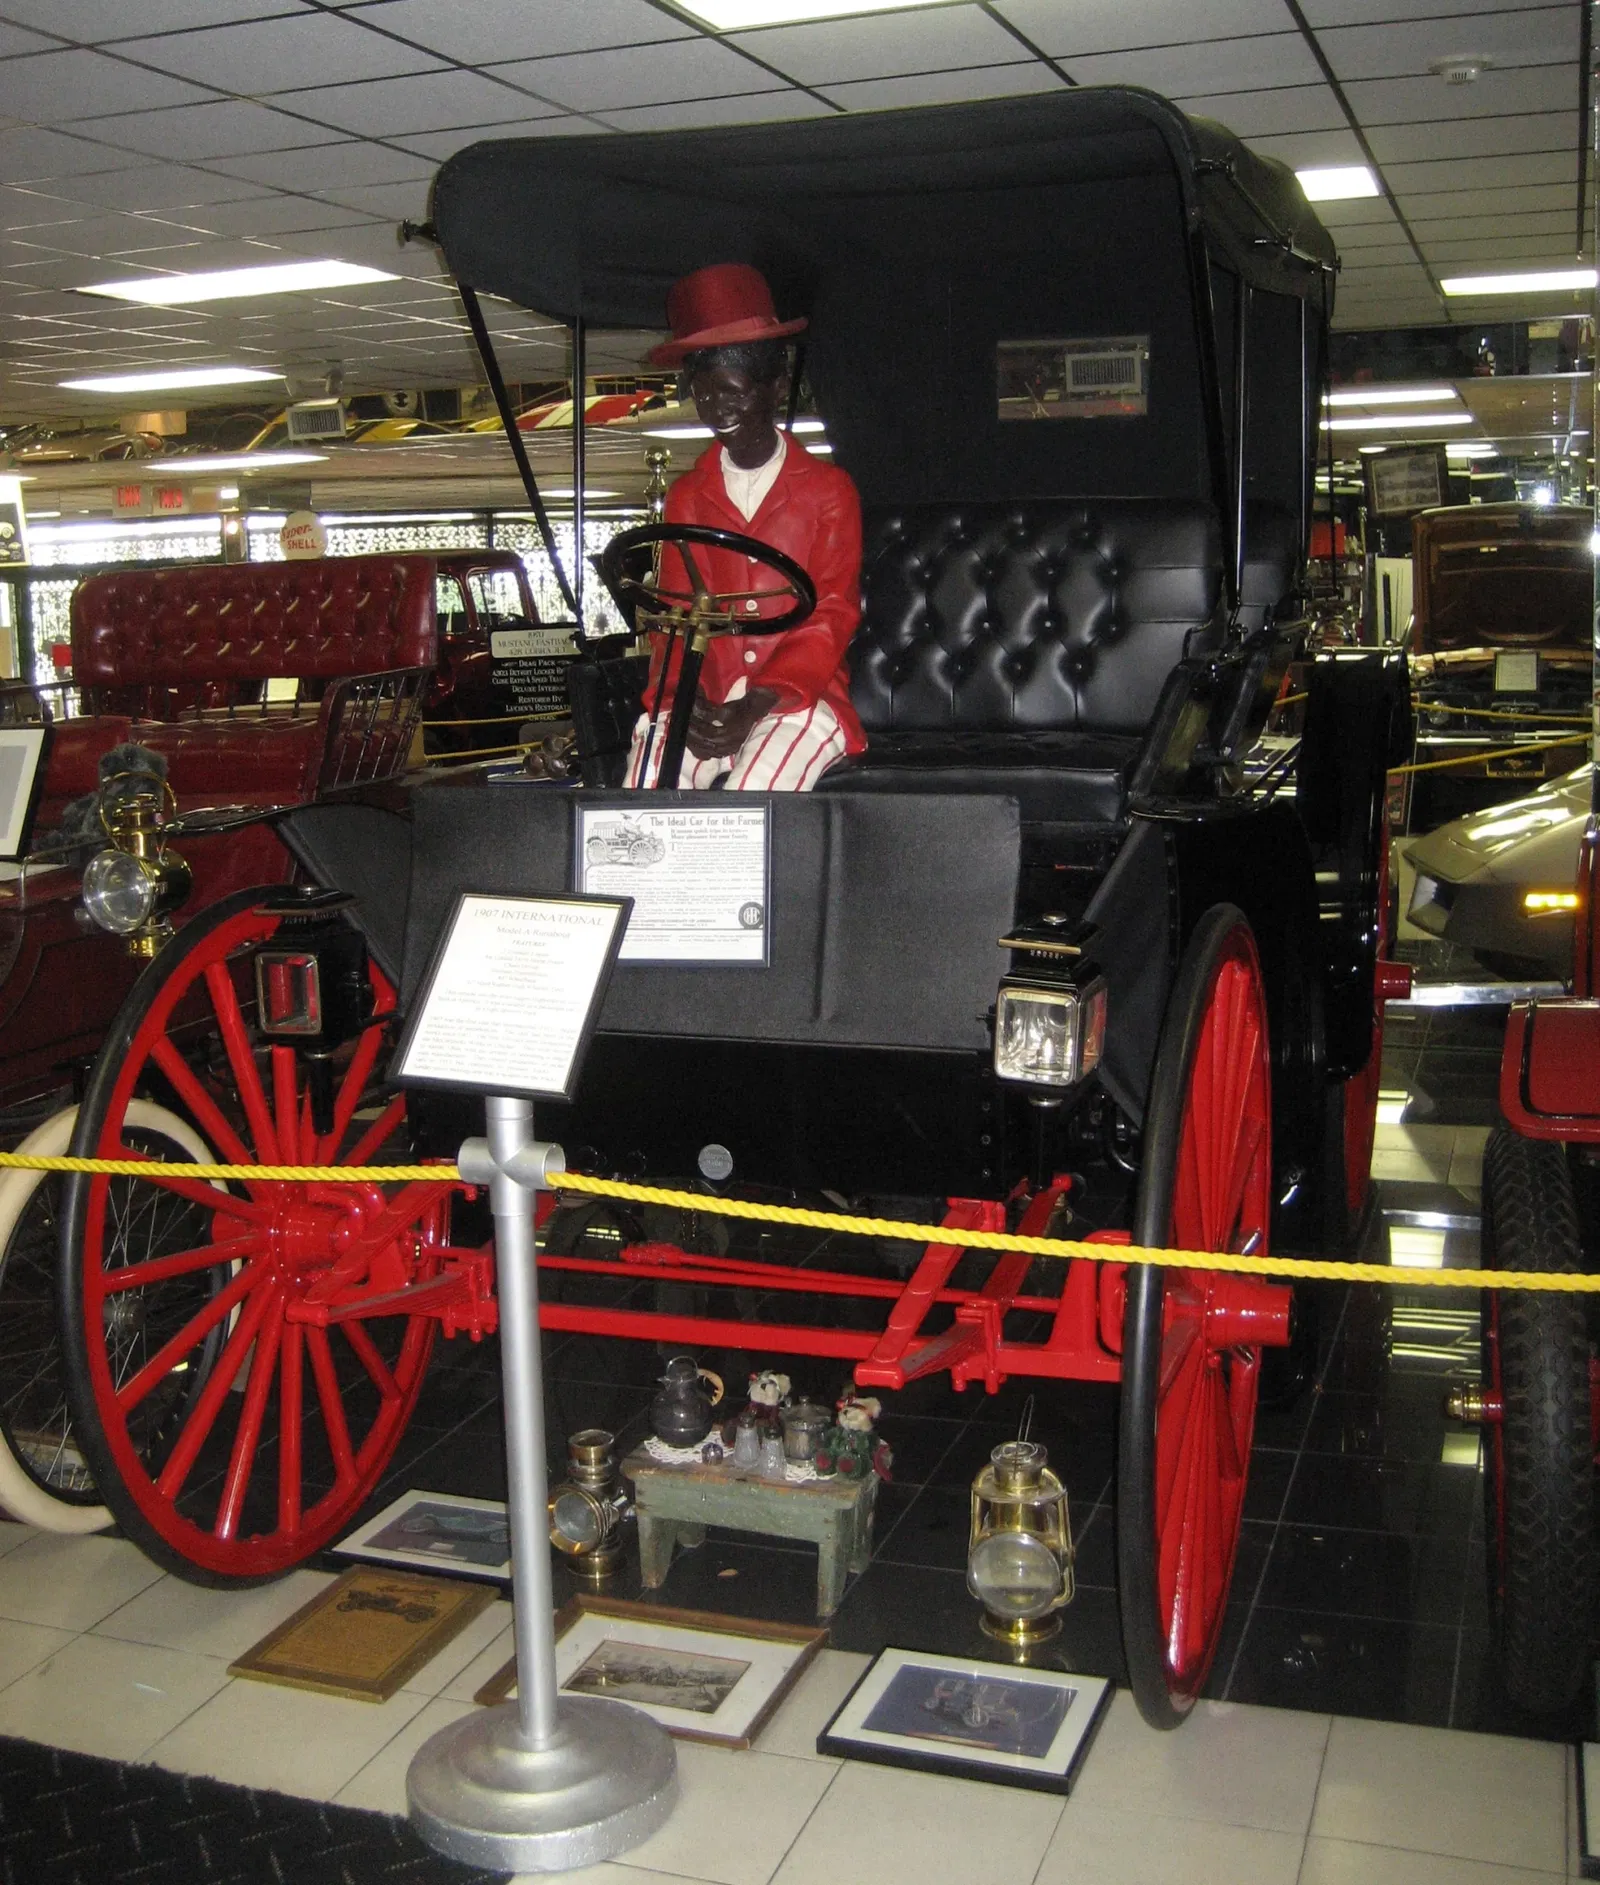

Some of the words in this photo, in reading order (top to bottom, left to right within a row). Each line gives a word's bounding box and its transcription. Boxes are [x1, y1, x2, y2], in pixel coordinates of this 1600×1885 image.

[117, 485, 141, 508] EXIT
[287, 538, 317, 550] SHELL
[498, 639, 534, 648] MUSTANG
[518, 659, 537, 668] DRAG
[538, 658, 556, 667] PACK
[511, 685, 537, 694] DELUXE
[518, 695, 551, 704] RESTORED
[650, 816, 664, 827] The
[667, 816, 687, 826] Ideal
[689, 815, 703, 826] Car
[707, 815, 719, 825] for
[722, 814, 735, 825] the
[474, 908, 500, 918] 1907
[501, 909, 605, 927] INTERNATIONAL
